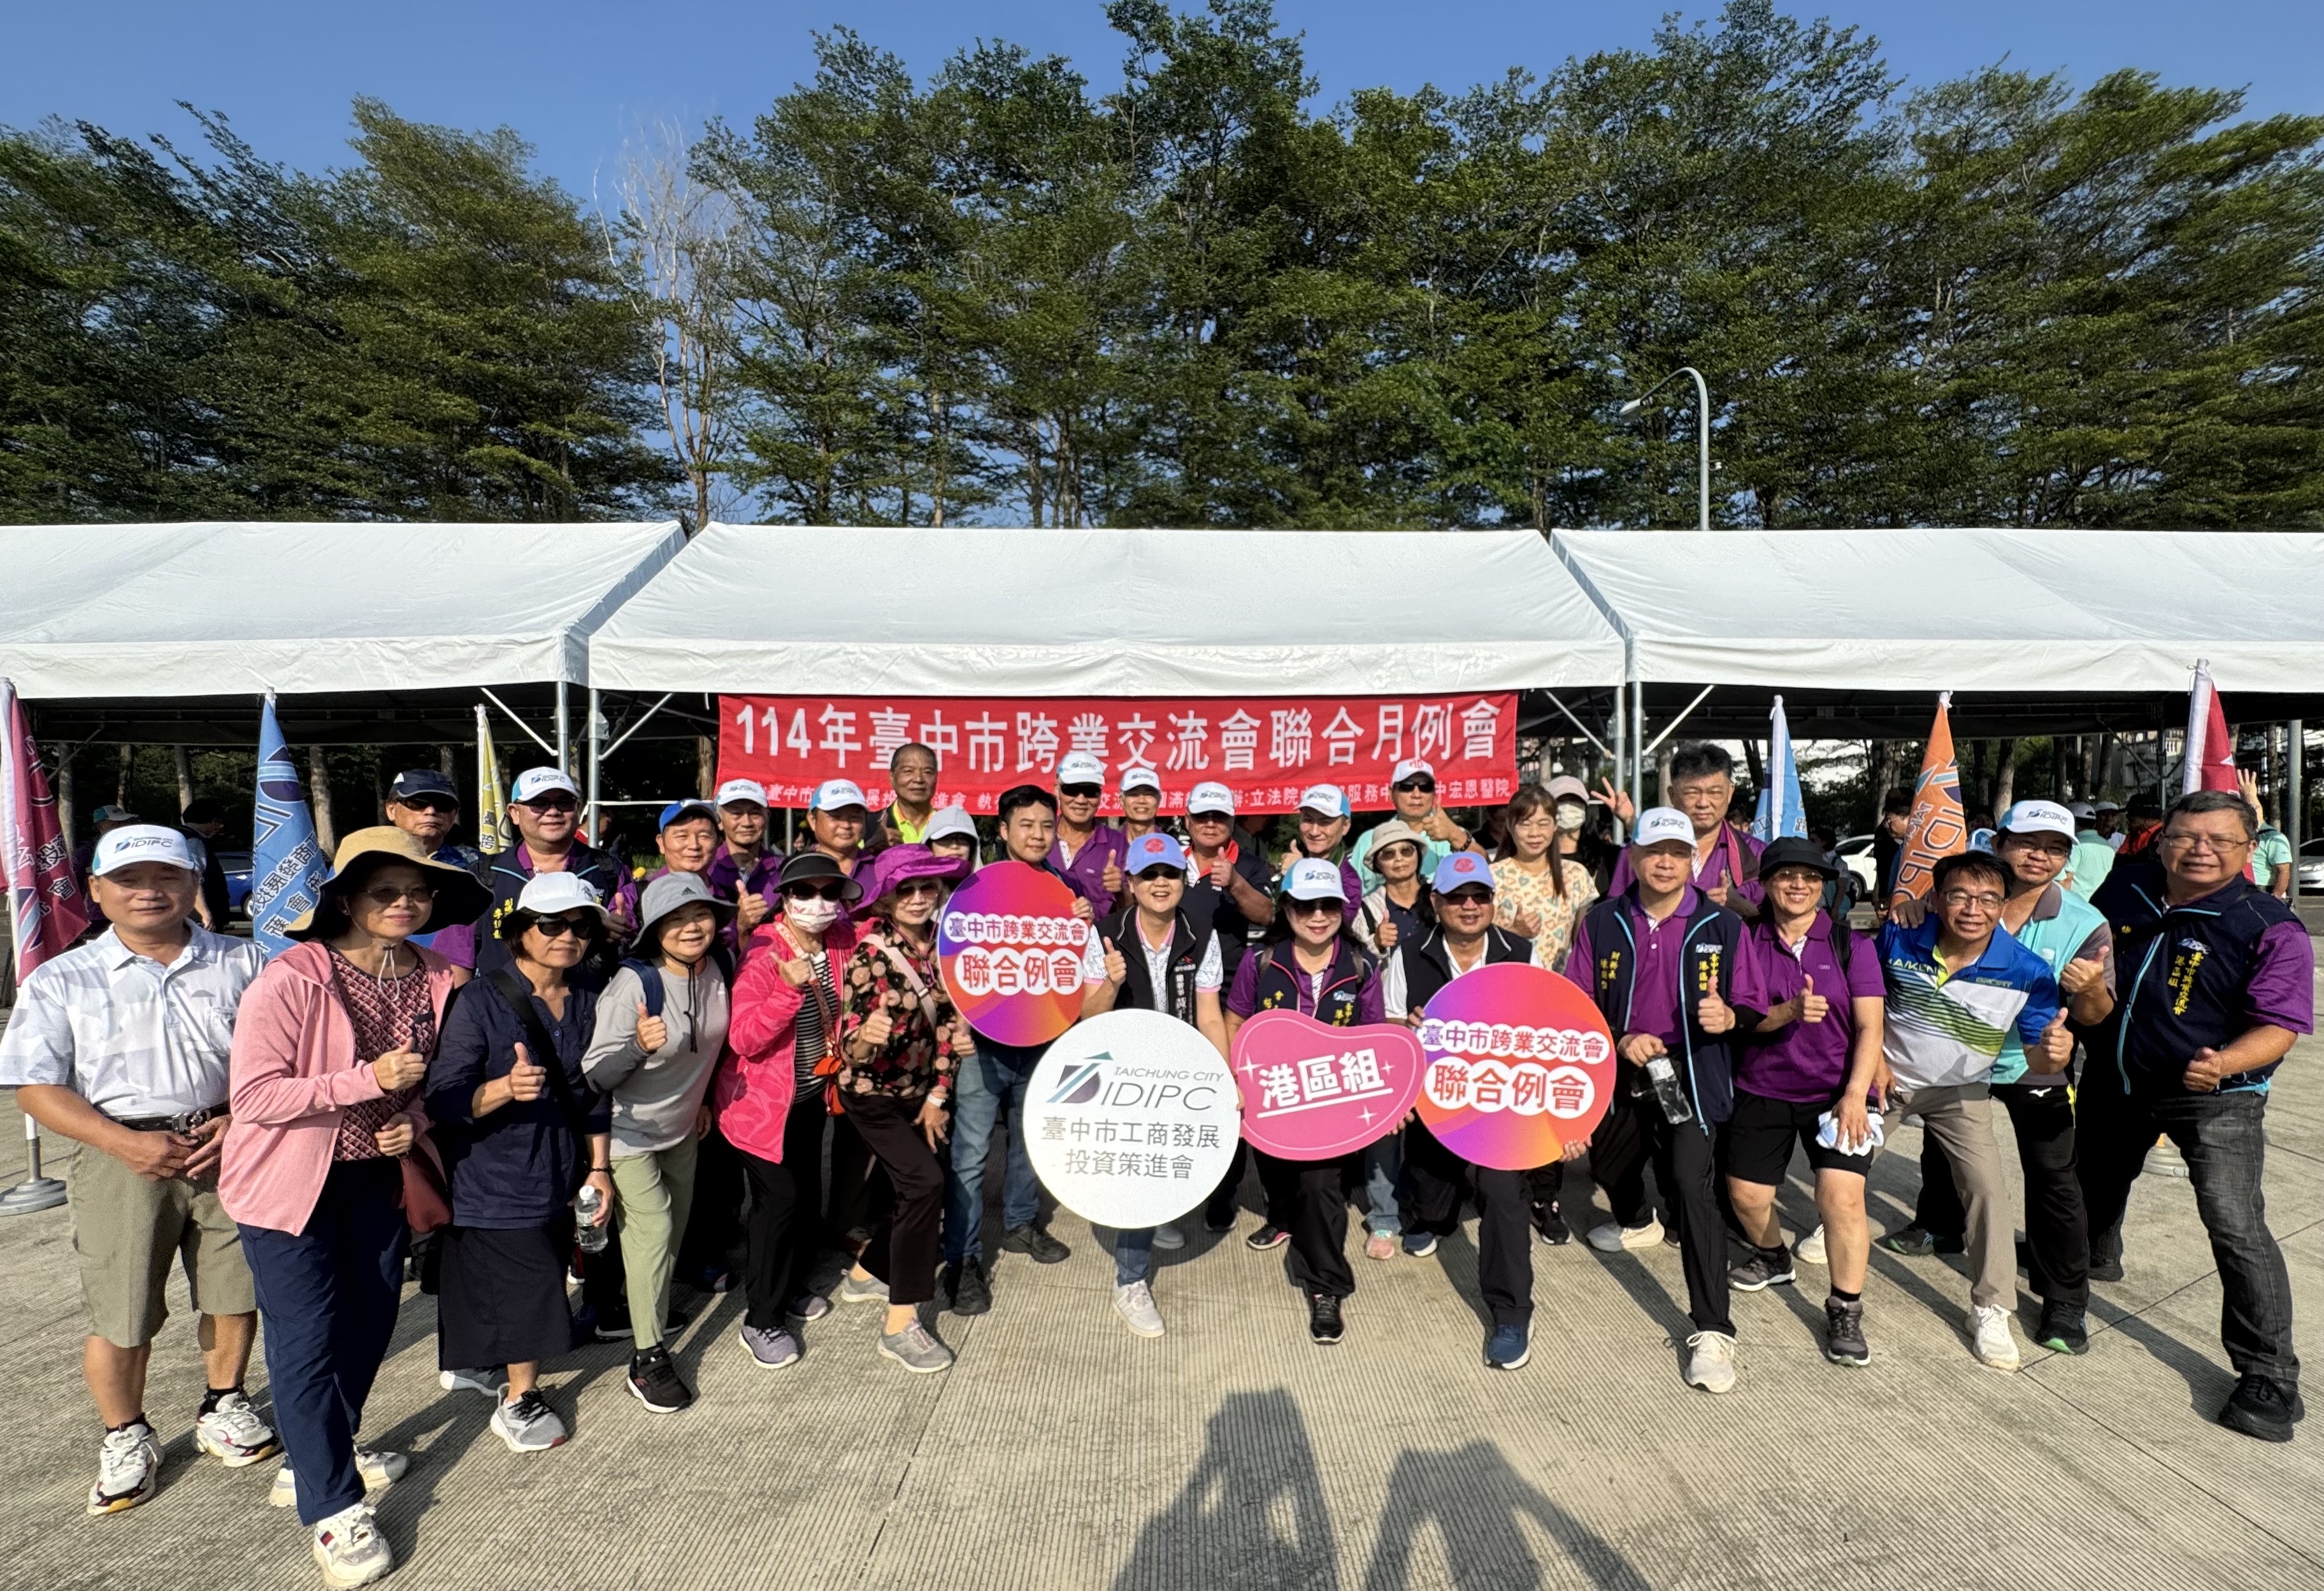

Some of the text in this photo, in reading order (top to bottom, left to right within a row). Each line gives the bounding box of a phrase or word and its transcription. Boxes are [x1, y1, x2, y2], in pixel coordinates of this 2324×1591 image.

[736, 700, 1500, 773] 114年臺中市跨業交流會聯合月例會
[949, 918, 1085, 941] 臺中市跨業交流會
[962, 954, 1078, 988] 聯合例會
[1423, 1024, 1604, 1059] 臺中市跨業交流會
[1115, 1066, 1224, 1082] TAICHUNG CITY
[1258, 1048, 1386, 1109] 港區組
[1433, 1064, 1588, 1111] 聯合例會
[1101, 1081, 1217, 1111] IDIPC
[1042, 1116, 1221, 1149] 臺中市工商發展
[1065, 1148, 1194, 1179] 投資策進會
